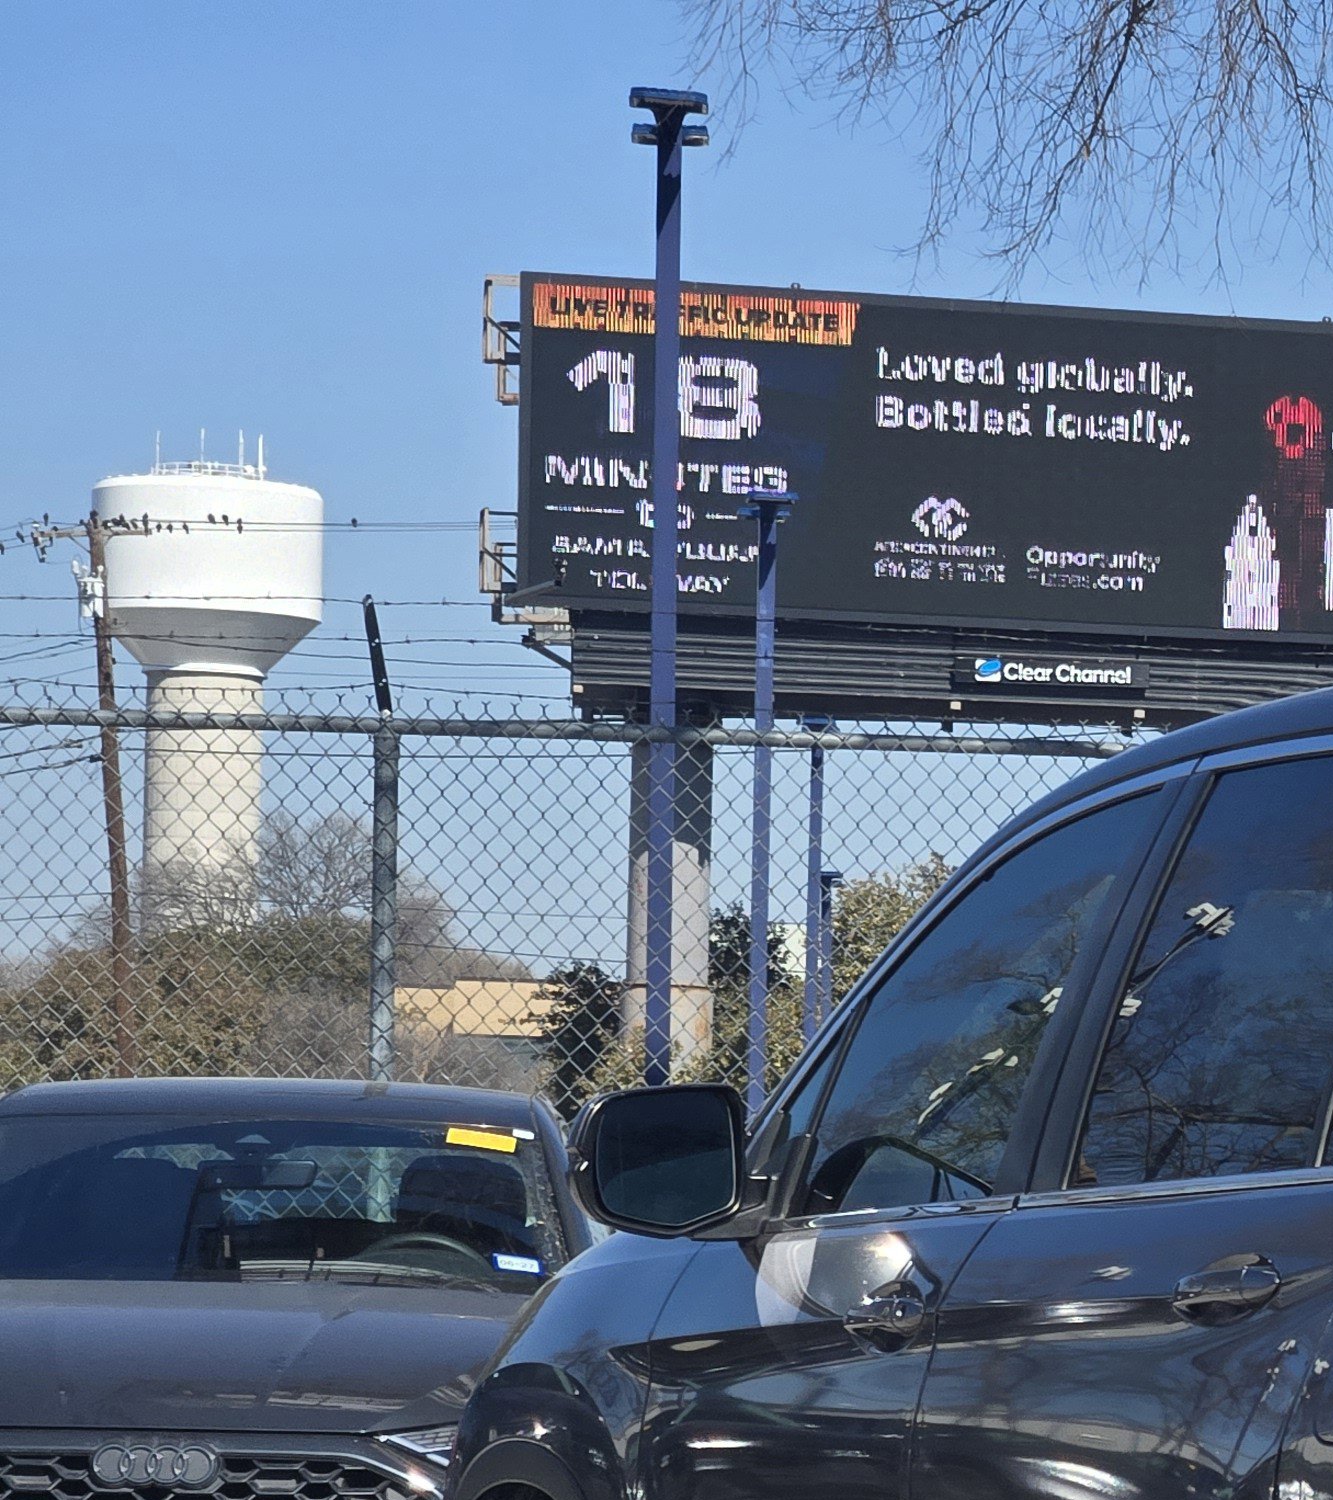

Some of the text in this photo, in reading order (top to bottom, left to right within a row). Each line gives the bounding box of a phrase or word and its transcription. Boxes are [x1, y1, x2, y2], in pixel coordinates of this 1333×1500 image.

[737, 309, 840, 332] UPDATE
[876, 347, 1004, 386] Loved
[876, 395, 1191, 451] Bottled locally.
[545, 454, 788, 494] MINTES
[1003, 662, 1132, 685] Clear Channel
